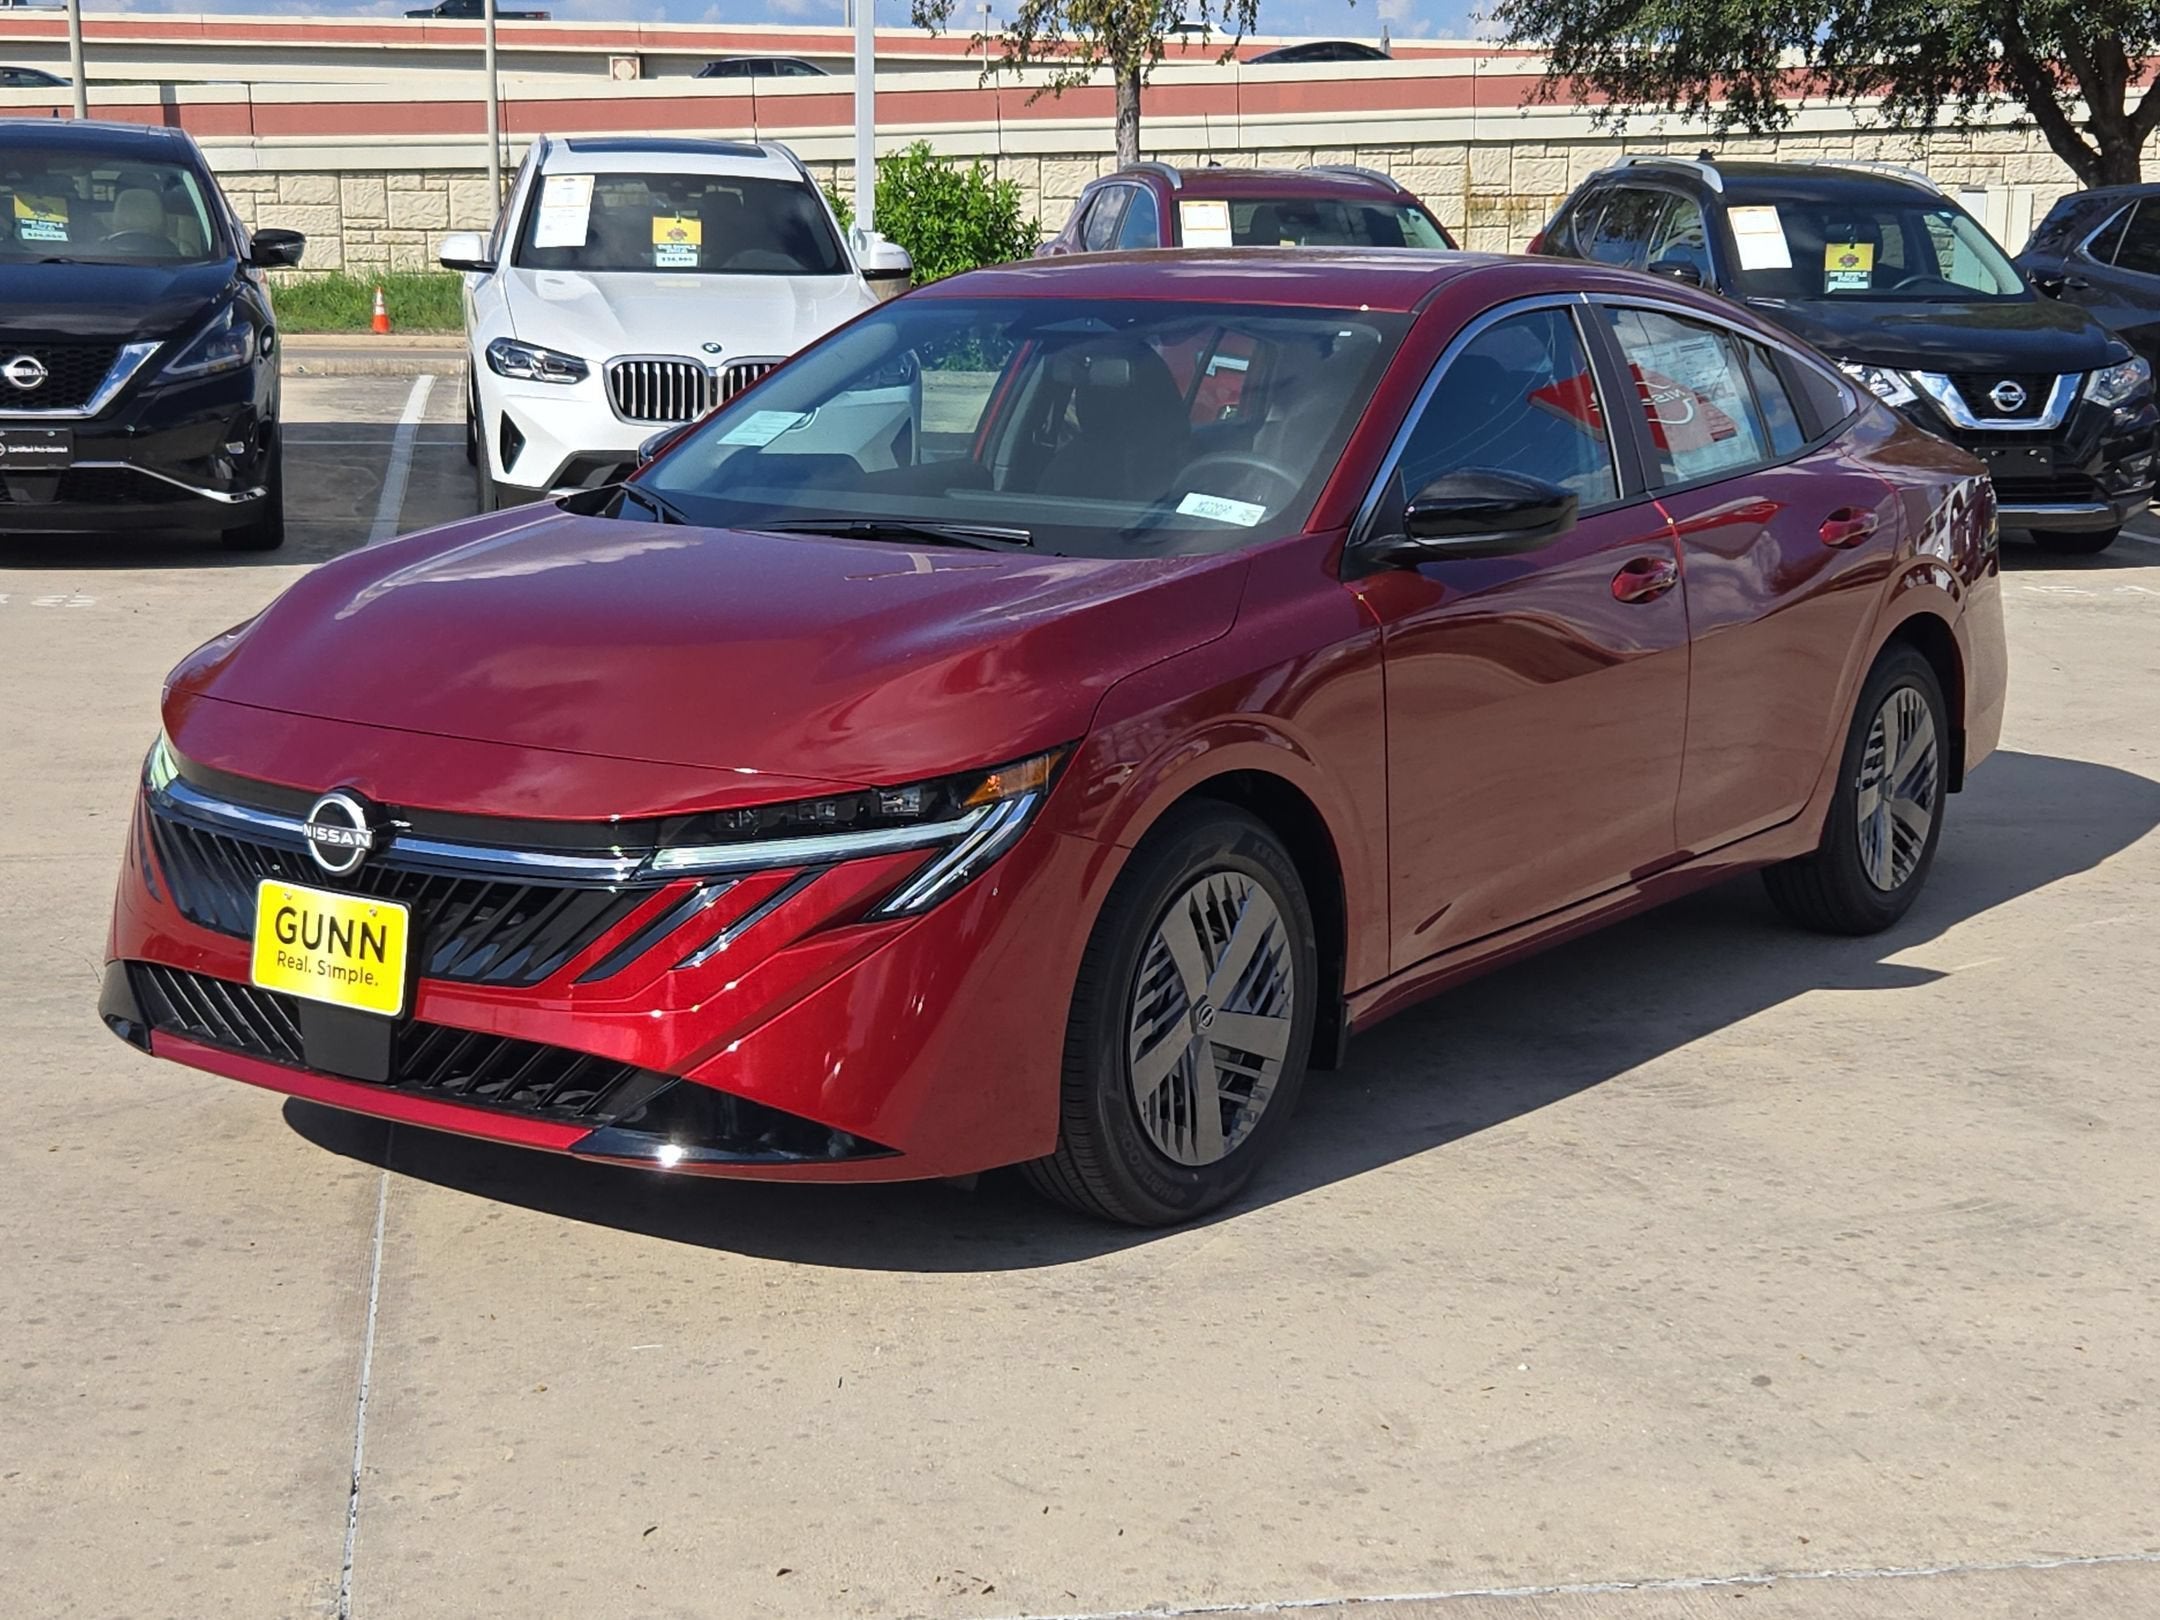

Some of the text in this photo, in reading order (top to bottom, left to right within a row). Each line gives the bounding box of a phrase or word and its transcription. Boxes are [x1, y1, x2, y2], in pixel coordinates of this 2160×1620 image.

[302, 823, 371, 847] NISSAN
[275, 906, 388, 964] GUNN
[277, 950, 379, 986] Real. Simple.
